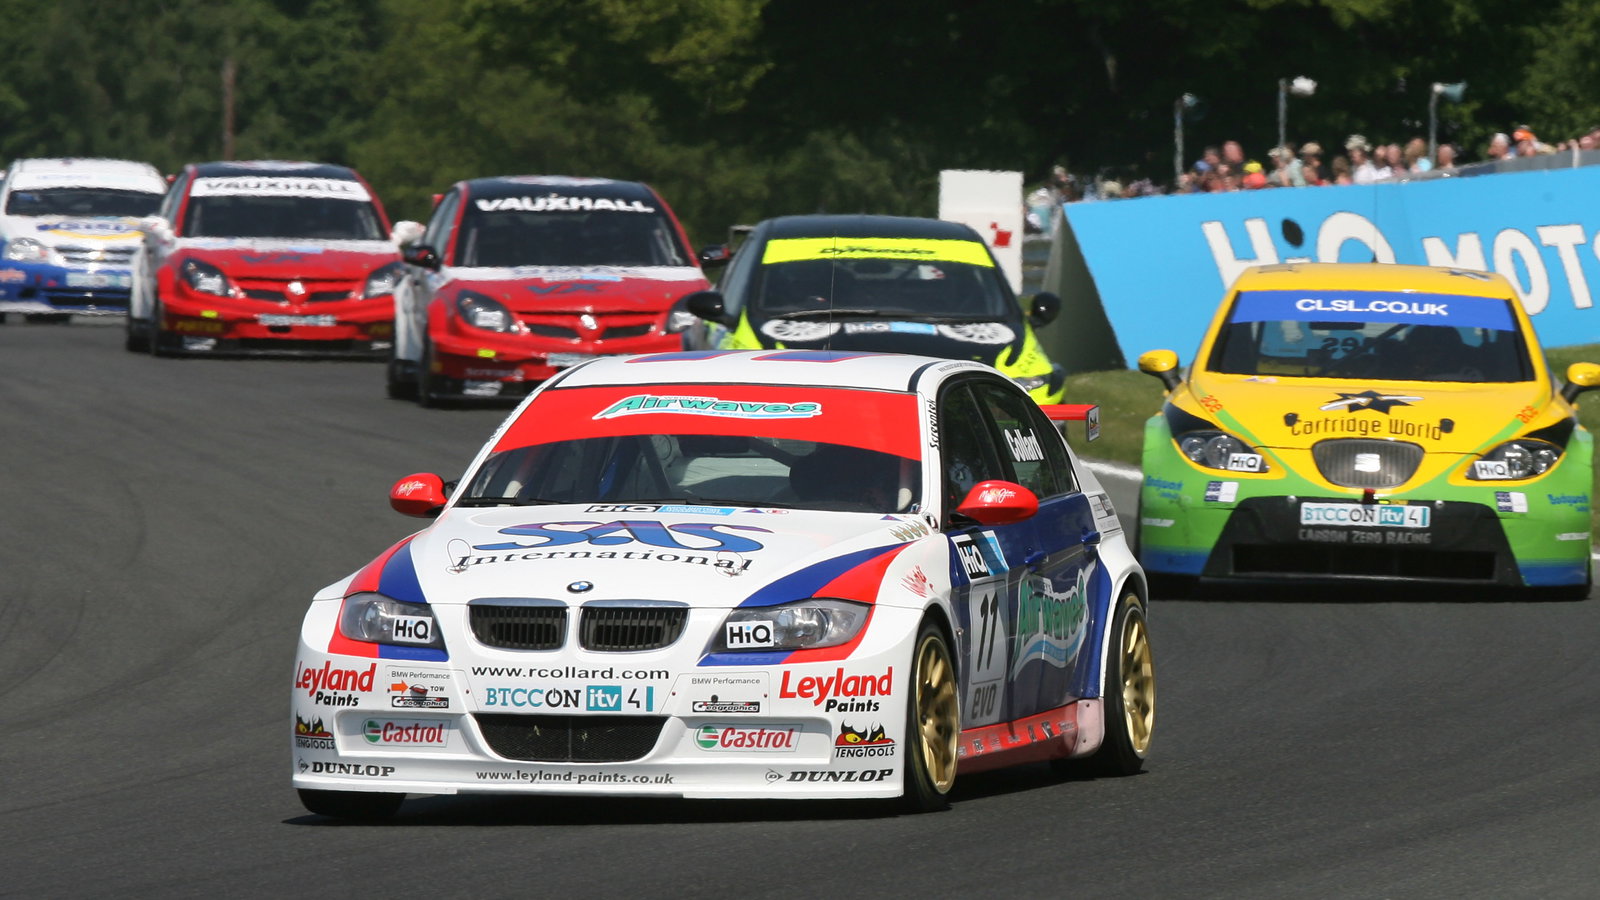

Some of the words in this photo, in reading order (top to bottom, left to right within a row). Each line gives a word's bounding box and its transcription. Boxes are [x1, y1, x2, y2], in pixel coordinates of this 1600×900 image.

[205, 177, 357, 194] VAUXHALL
[475, 196, 656, 213] VAUXHALL
[1422, 224, 1600, 316] MOT
[1295, 298, 1449, 316] CLSL.CO.UK
[599, 395, 818, 417] Airwaves
[1200, 395, 1224, 414] ace
[1515, 405, 1539, 424] ace
[1292, 417, 1381, 436] Cartridge
[1389, 419, 1444, 441] World
[1004, 427, 1045, 463] Collard
[1230, 455, 1258, 470] HiQ
[1478, 464, 1506, 476] HiQ
[587, 505, 657, 513] HiQ
[1408, 508, 1418, 524] 4
[472, 519, 775, 553] SAS
[1299, 528, 1348, 544] CARBON
[1352, 530, 1383, 544] ZERO
[1386, 531, 1433, 545] RACING
[456, 549, 753, 573] International
[960, 545, 988, 574] HiQ
[394, 619, 431, 641] HiQ
[729, 625, 771, 644] HiQ
[976, 592, 998, 673] 11
[295, 660, 377, 697] Leyland
[471, 666, 670, 680] www.rcollard.com
[692, 677, 711, 685] BMW
[712, 677, 761, 685] Performance
[779, 666, 893, 706] Leyland
[315, 690, 360, 707] Paints
[588, 689, 620, 709] itv
[627, 687, 641, 709] 4
[824, 699, 880, 713] Paints
[971, 683, 998, 721] evo
[382, 721, 444, 744] Castrol
[720, 727, 795, 749] Castrol
[312, 761, 396, 777] DUNLOP
[476, 769, 675, 785] www.leyland-paints.co.uk
[786, 768, 894, 783] DUNLOP
